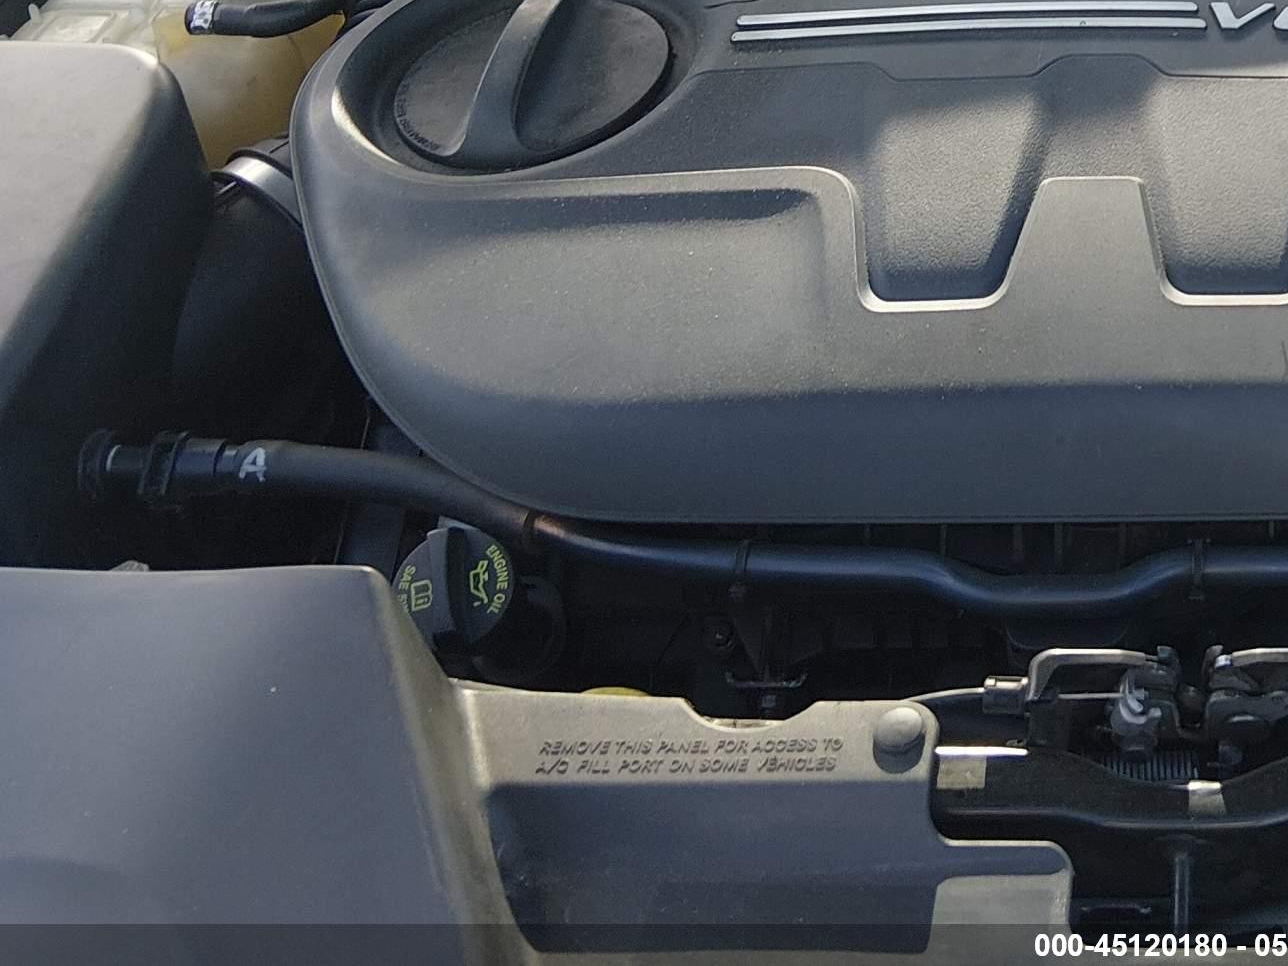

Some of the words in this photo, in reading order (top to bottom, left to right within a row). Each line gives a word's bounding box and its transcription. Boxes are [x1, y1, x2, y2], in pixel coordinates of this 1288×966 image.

[238, 446, 267, 482] A
[398, 564, 416, 591] SAE
[485, 544, 509, 591] ENGINE
[487, 592, 506, 614] OIL
[539, 740, 611, 757] REMOVE
[613, 739, 652, 755] THIS
[656, 738, 710, 755] PANEL
[714, 738, 750, 754] FOR
[751, 737, 819, 754] ACCESS
[822, 736, 844, 753] TO
[535, 758, 570, 776] A/C
[576, 758, 611, 775] FILL
[617, 758, 664, 775] PORT
[668, 758, 695, 775] ON
[698, 757, 751, 774] SOME
[757, 755, 838, 774] VEHICLES
